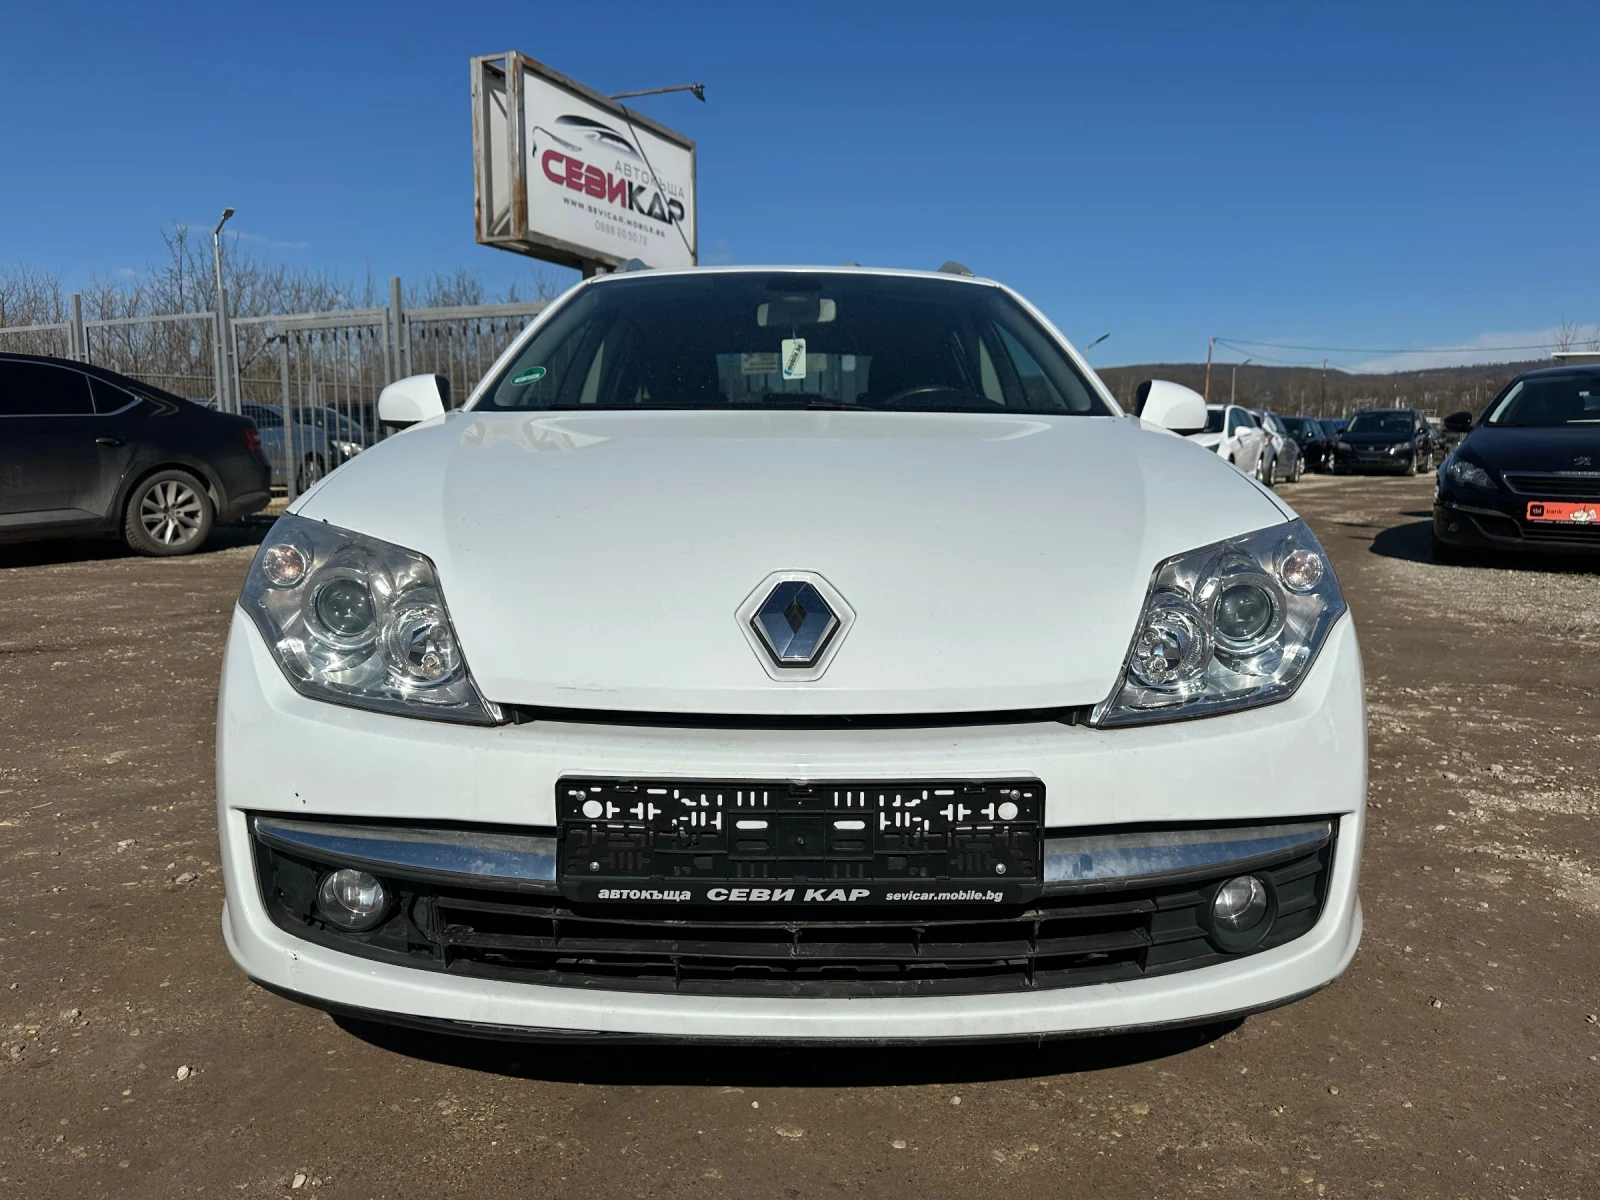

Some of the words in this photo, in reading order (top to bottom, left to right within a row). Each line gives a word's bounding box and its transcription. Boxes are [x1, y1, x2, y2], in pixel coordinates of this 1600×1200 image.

[597, 888, 692, 902] автокъща
[706, 887, 796, 902] СЕВИ
[803, 888, 871, 902] КАР
[885, 890, 1004, 903] sevicar.mobile.bg
